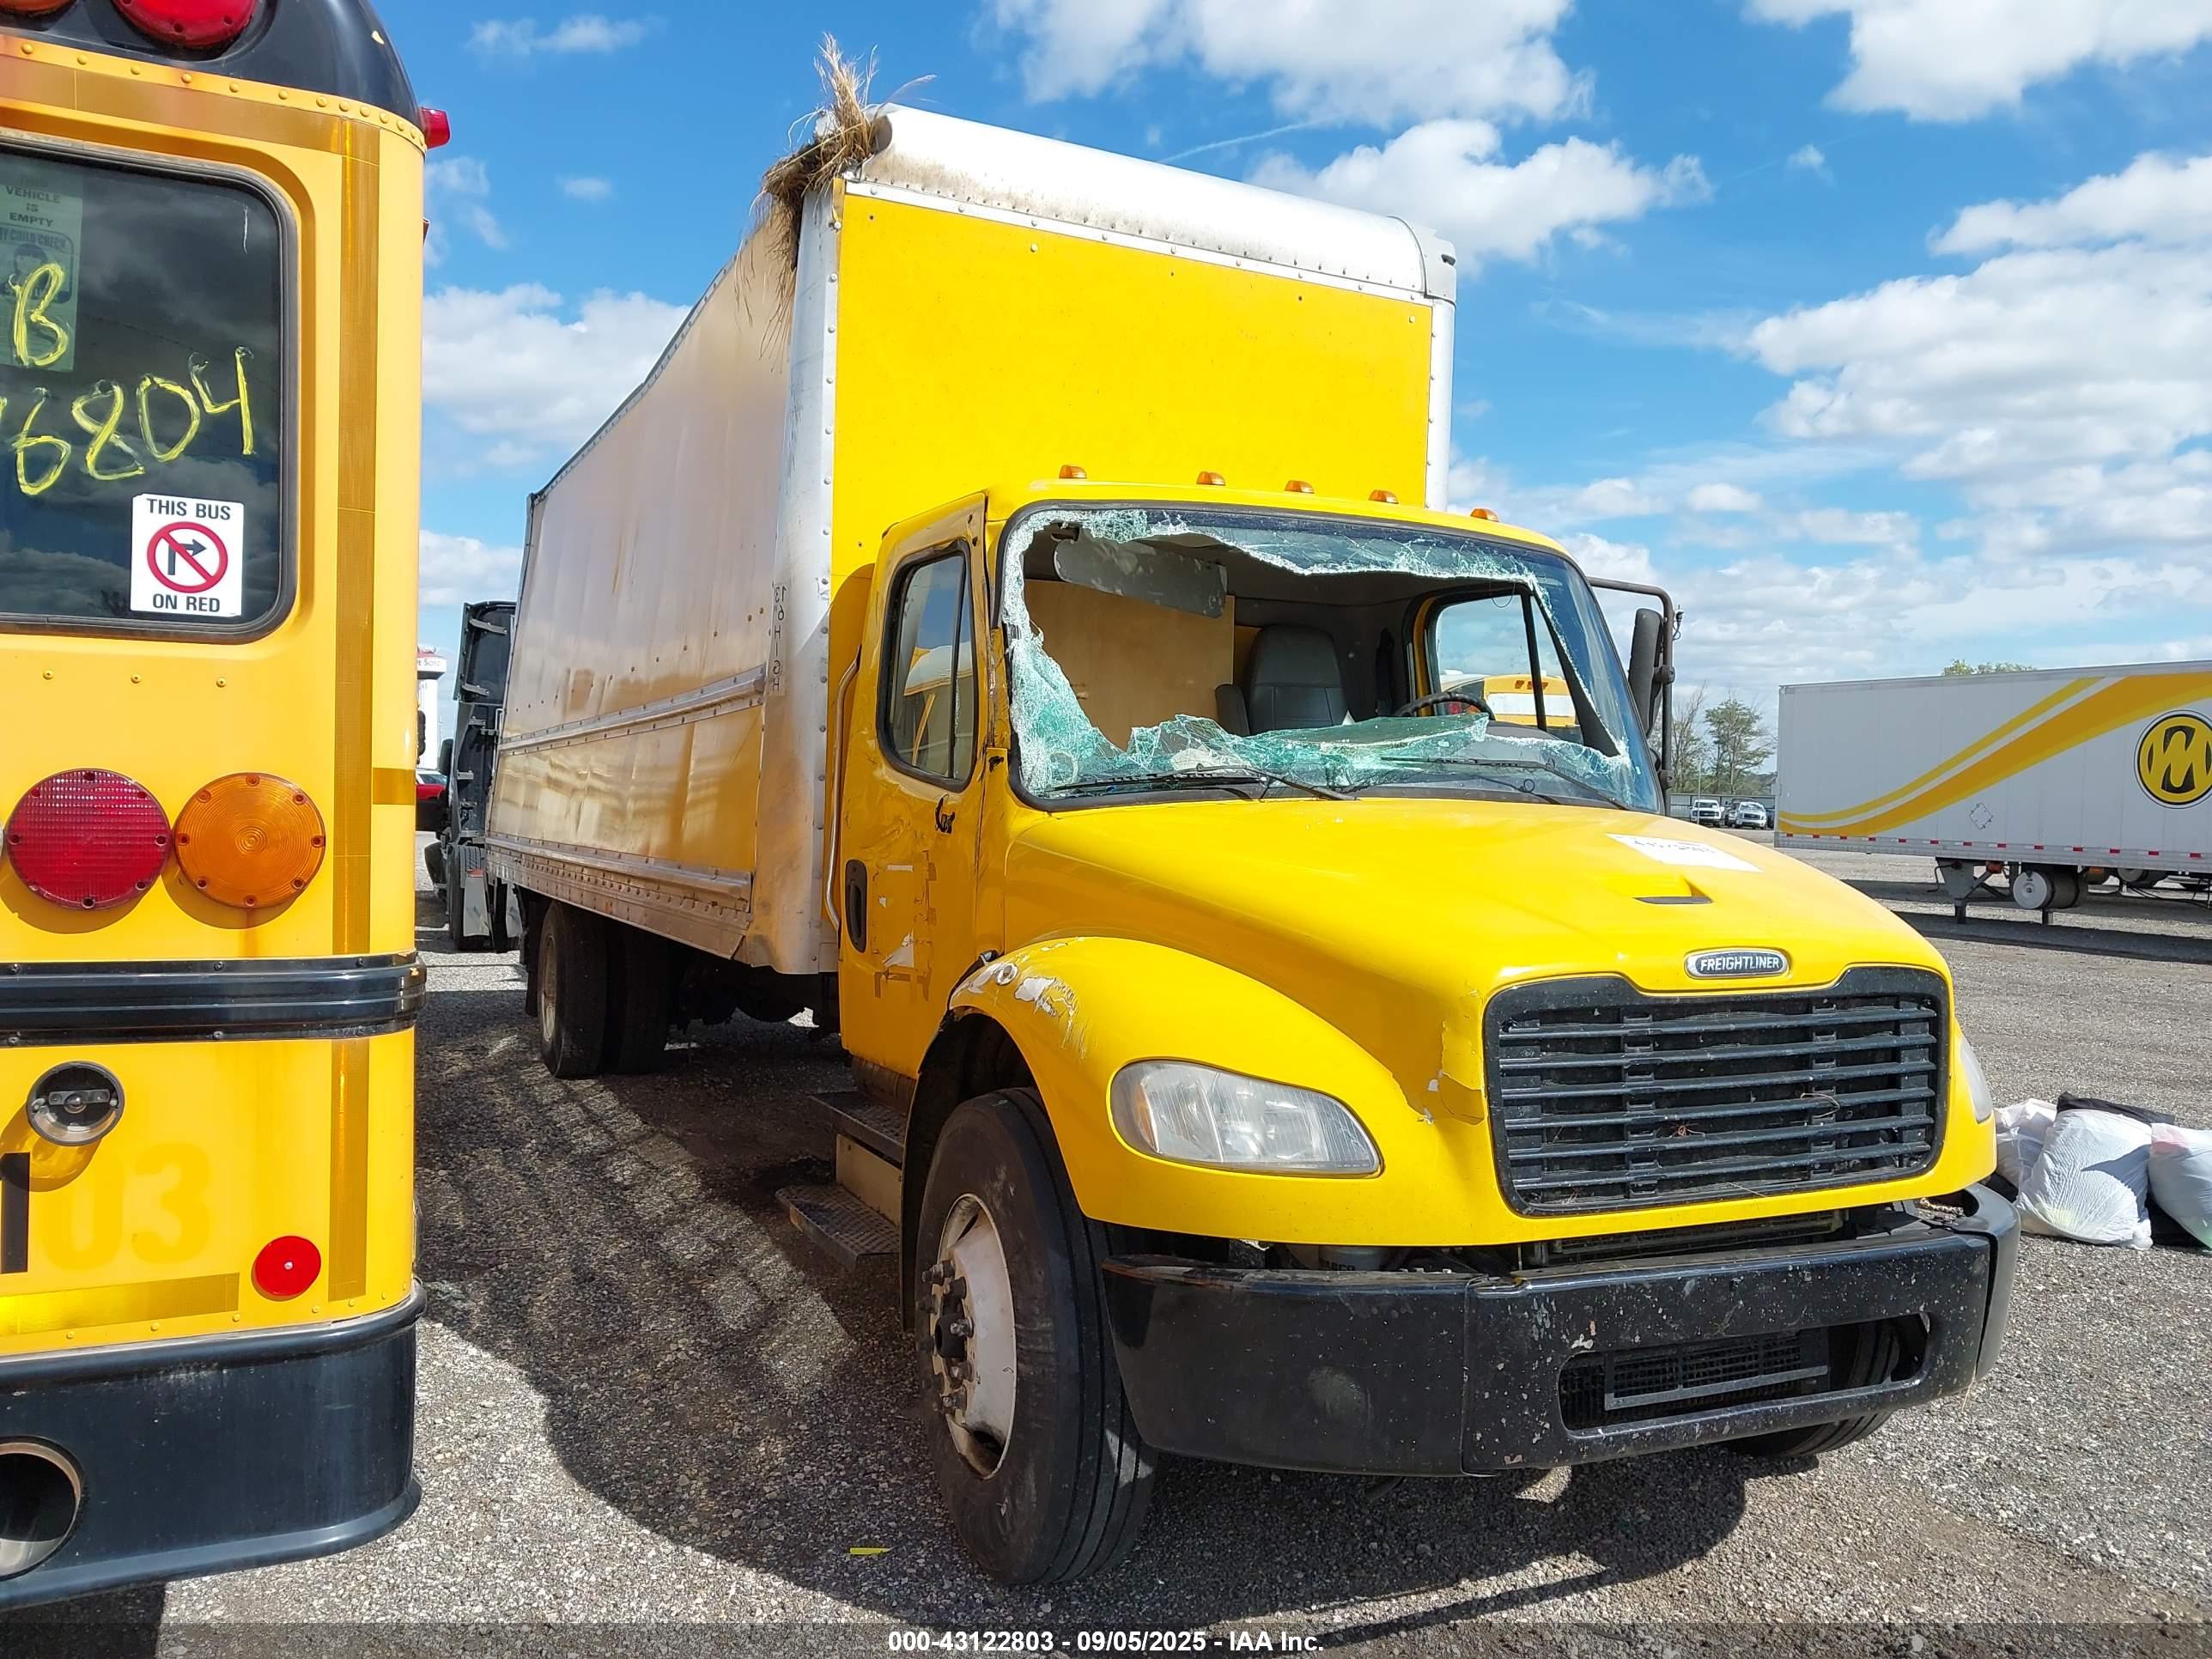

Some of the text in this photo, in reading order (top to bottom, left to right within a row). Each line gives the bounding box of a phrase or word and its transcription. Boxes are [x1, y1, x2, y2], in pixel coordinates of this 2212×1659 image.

[6, 185, 61, 204] VEHICLE
[26, 203, 39, 212] IS
[9, 212, 54, 227] EMPTY
[13, 262, 69, 368] B
[0, 346, 255, 495] 6804
[147, 498, 231, 520] THIS BUS
[153, 593, 220, 612] ON RED
[1700, 956, 1780, 971] FREIGHTLINER
